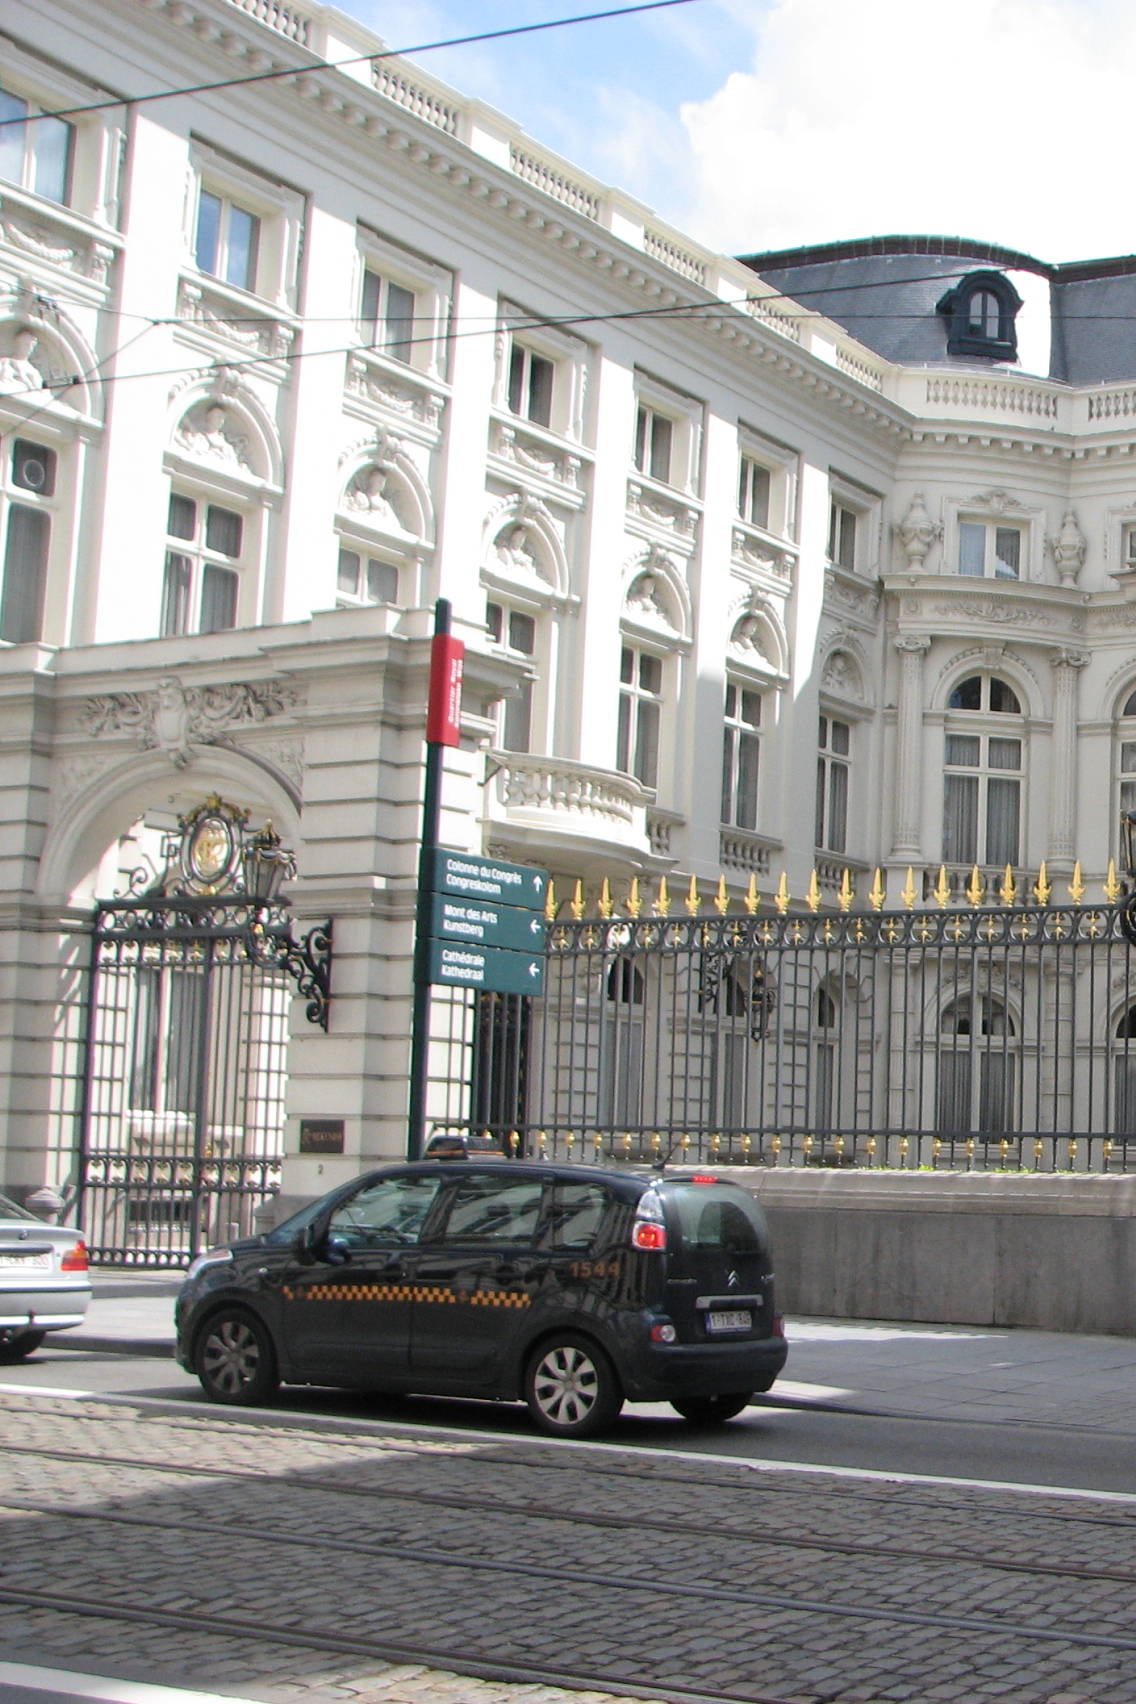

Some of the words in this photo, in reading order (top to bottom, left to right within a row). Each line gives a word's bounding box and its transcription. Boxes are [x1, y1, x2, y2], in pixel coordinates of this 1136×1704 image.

[446, 858, 479, 875] Colonne
[480, 865, 492, 877] du
[491, 868, 522, 885] Congrès
[445, 873, 502, 894] Congreskolom
[443, 904, 466, 918] Mont
[466, 907, 481, 920] des
[481, 910, 498, 924] Arts
[442, 919, 485, 937] Kunstberg
[442, 949, 485, 967] Cathédrale
[441, 964, 484, 981] Kathedraal
[569, 1261, 621, 1279] 1544
